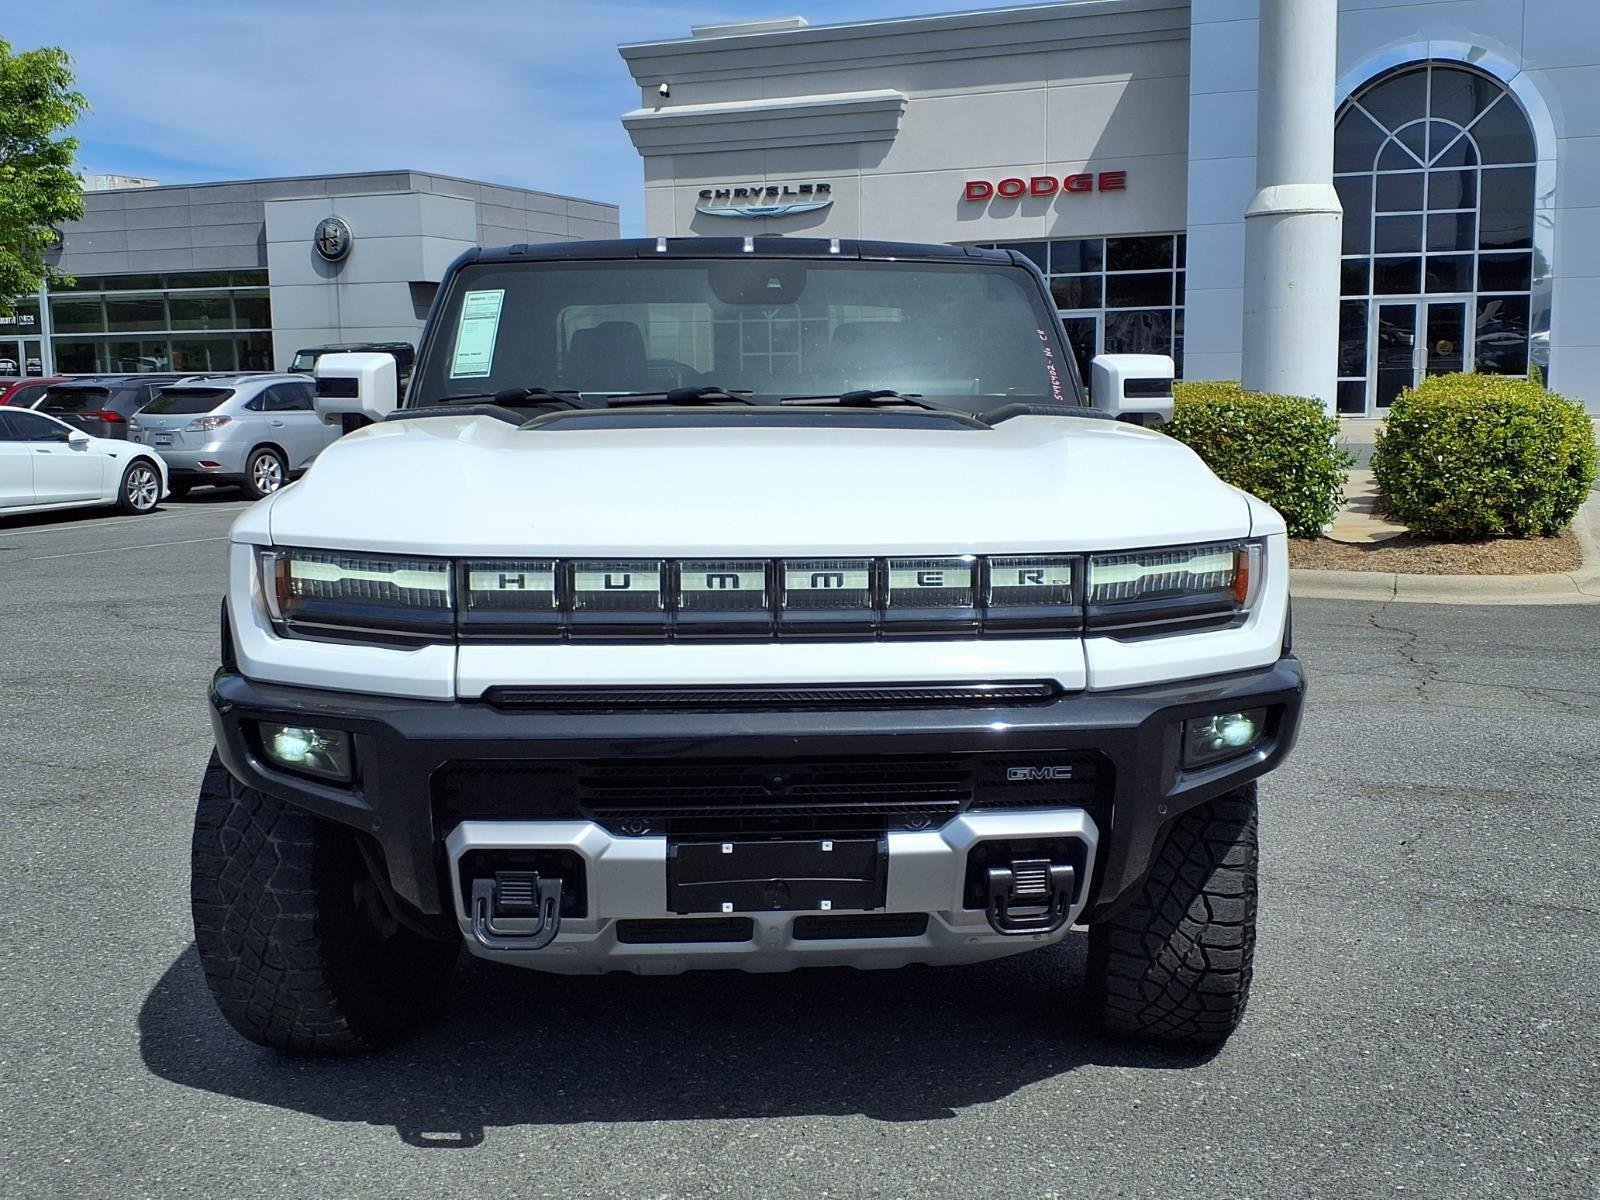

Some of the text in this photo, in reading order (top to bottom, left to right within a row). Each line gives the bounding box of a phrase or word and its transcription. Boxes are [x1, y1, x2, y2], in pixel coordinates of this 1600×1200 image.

[699, 183, 832, 199] CHRYSLER
[965, 171, 1127, 201] DODGE
[1007, 766, 1073, 781] GMC
